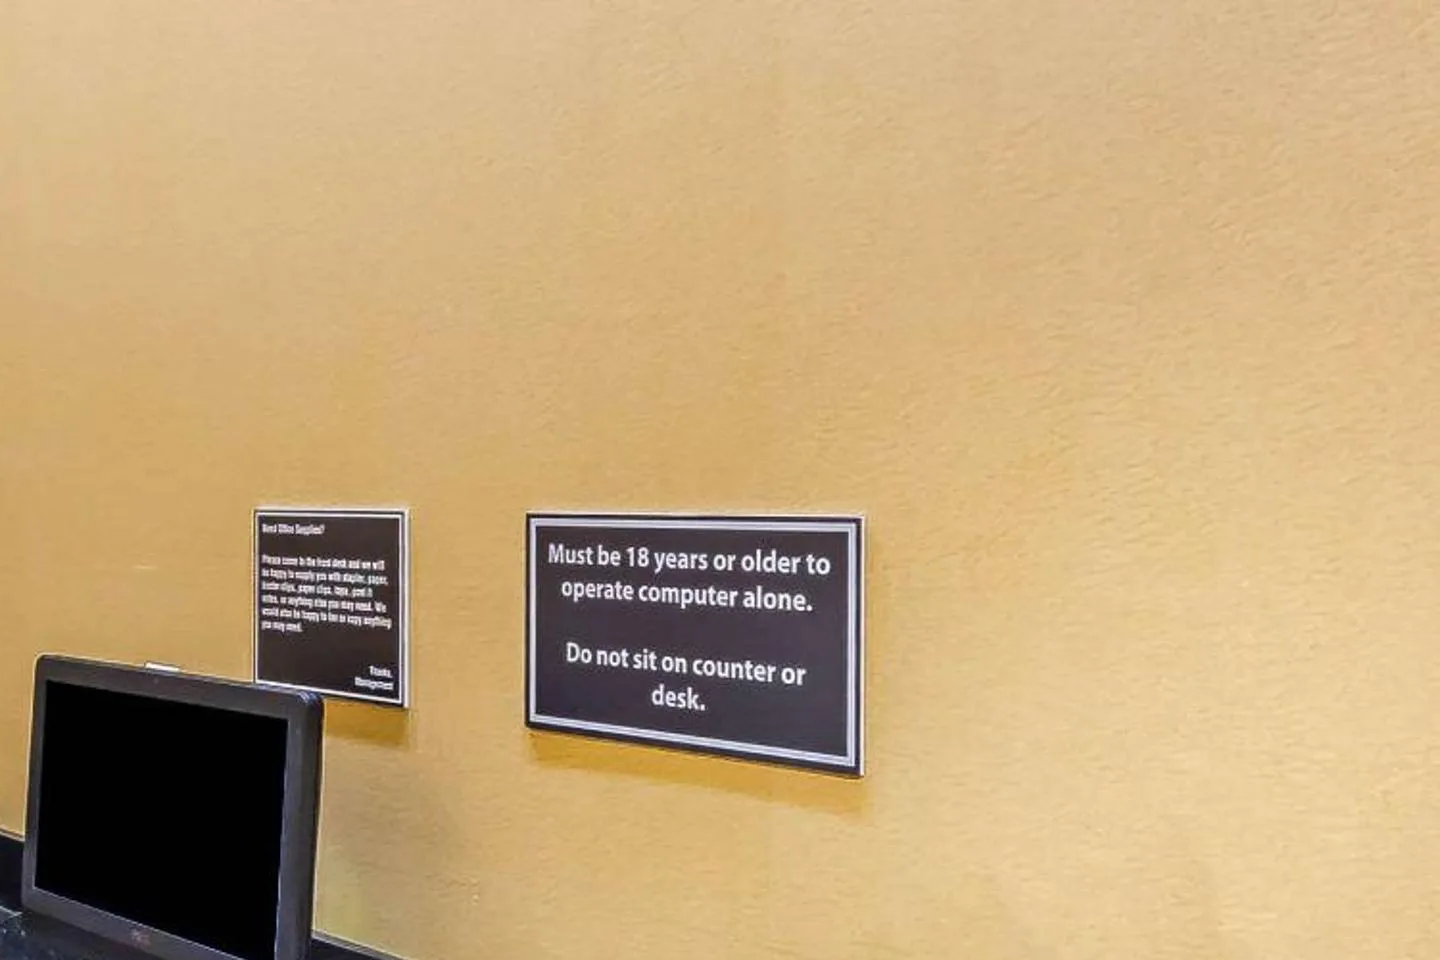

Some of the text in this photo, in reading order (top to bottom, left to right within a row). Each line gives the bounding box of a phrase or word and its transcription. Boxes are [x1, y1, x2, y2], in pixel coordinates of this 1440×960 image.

[548, 543, 831, 575] Must be 18 years or older to
[562, 580, 813, 612] operate computer alone.
[566, 642, 806, 685] Do not sit on counter or
[652, 684, 706, 711] desk.
